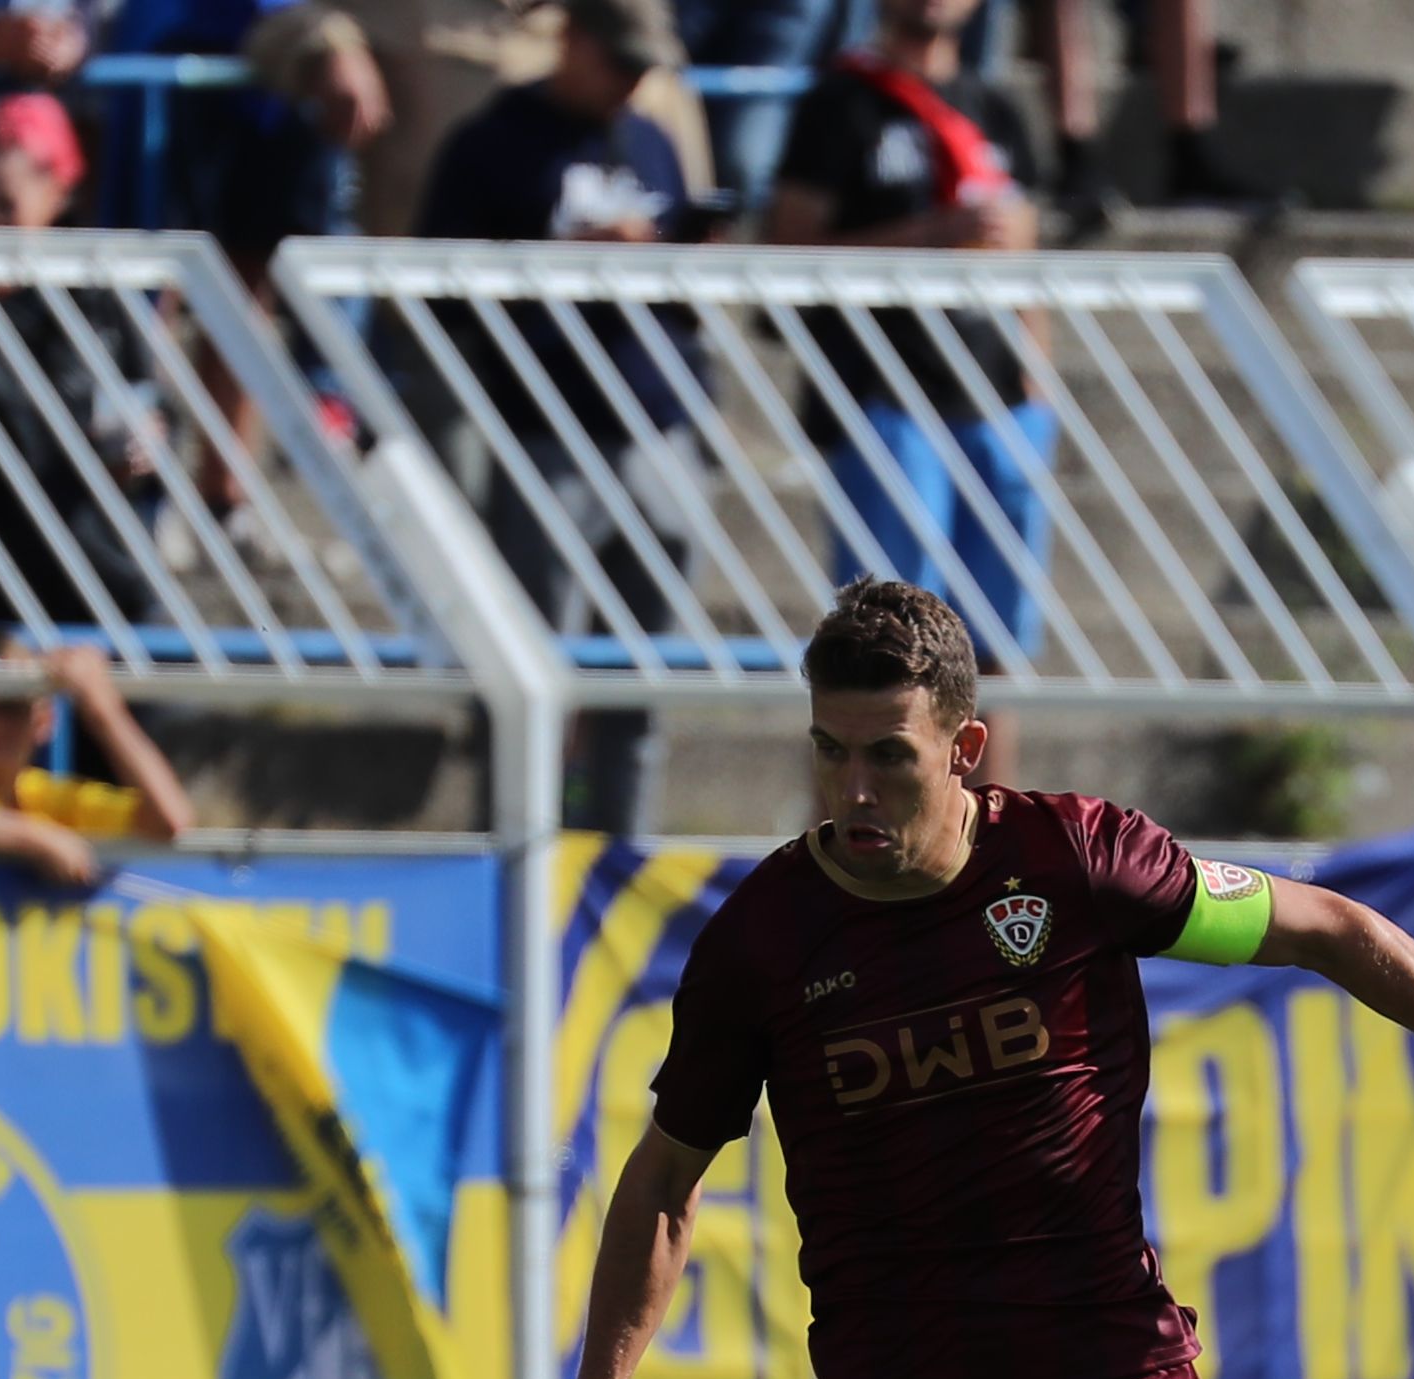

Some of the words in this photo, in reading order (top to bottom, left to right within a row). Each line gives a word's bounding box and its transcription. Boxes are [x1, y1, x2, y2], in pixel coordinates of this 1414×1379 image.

[990, 898, 1045, 925] BFC
[803, 970, 857, 1003] JAKO
[824, 997, 1050, 1105] DWB
